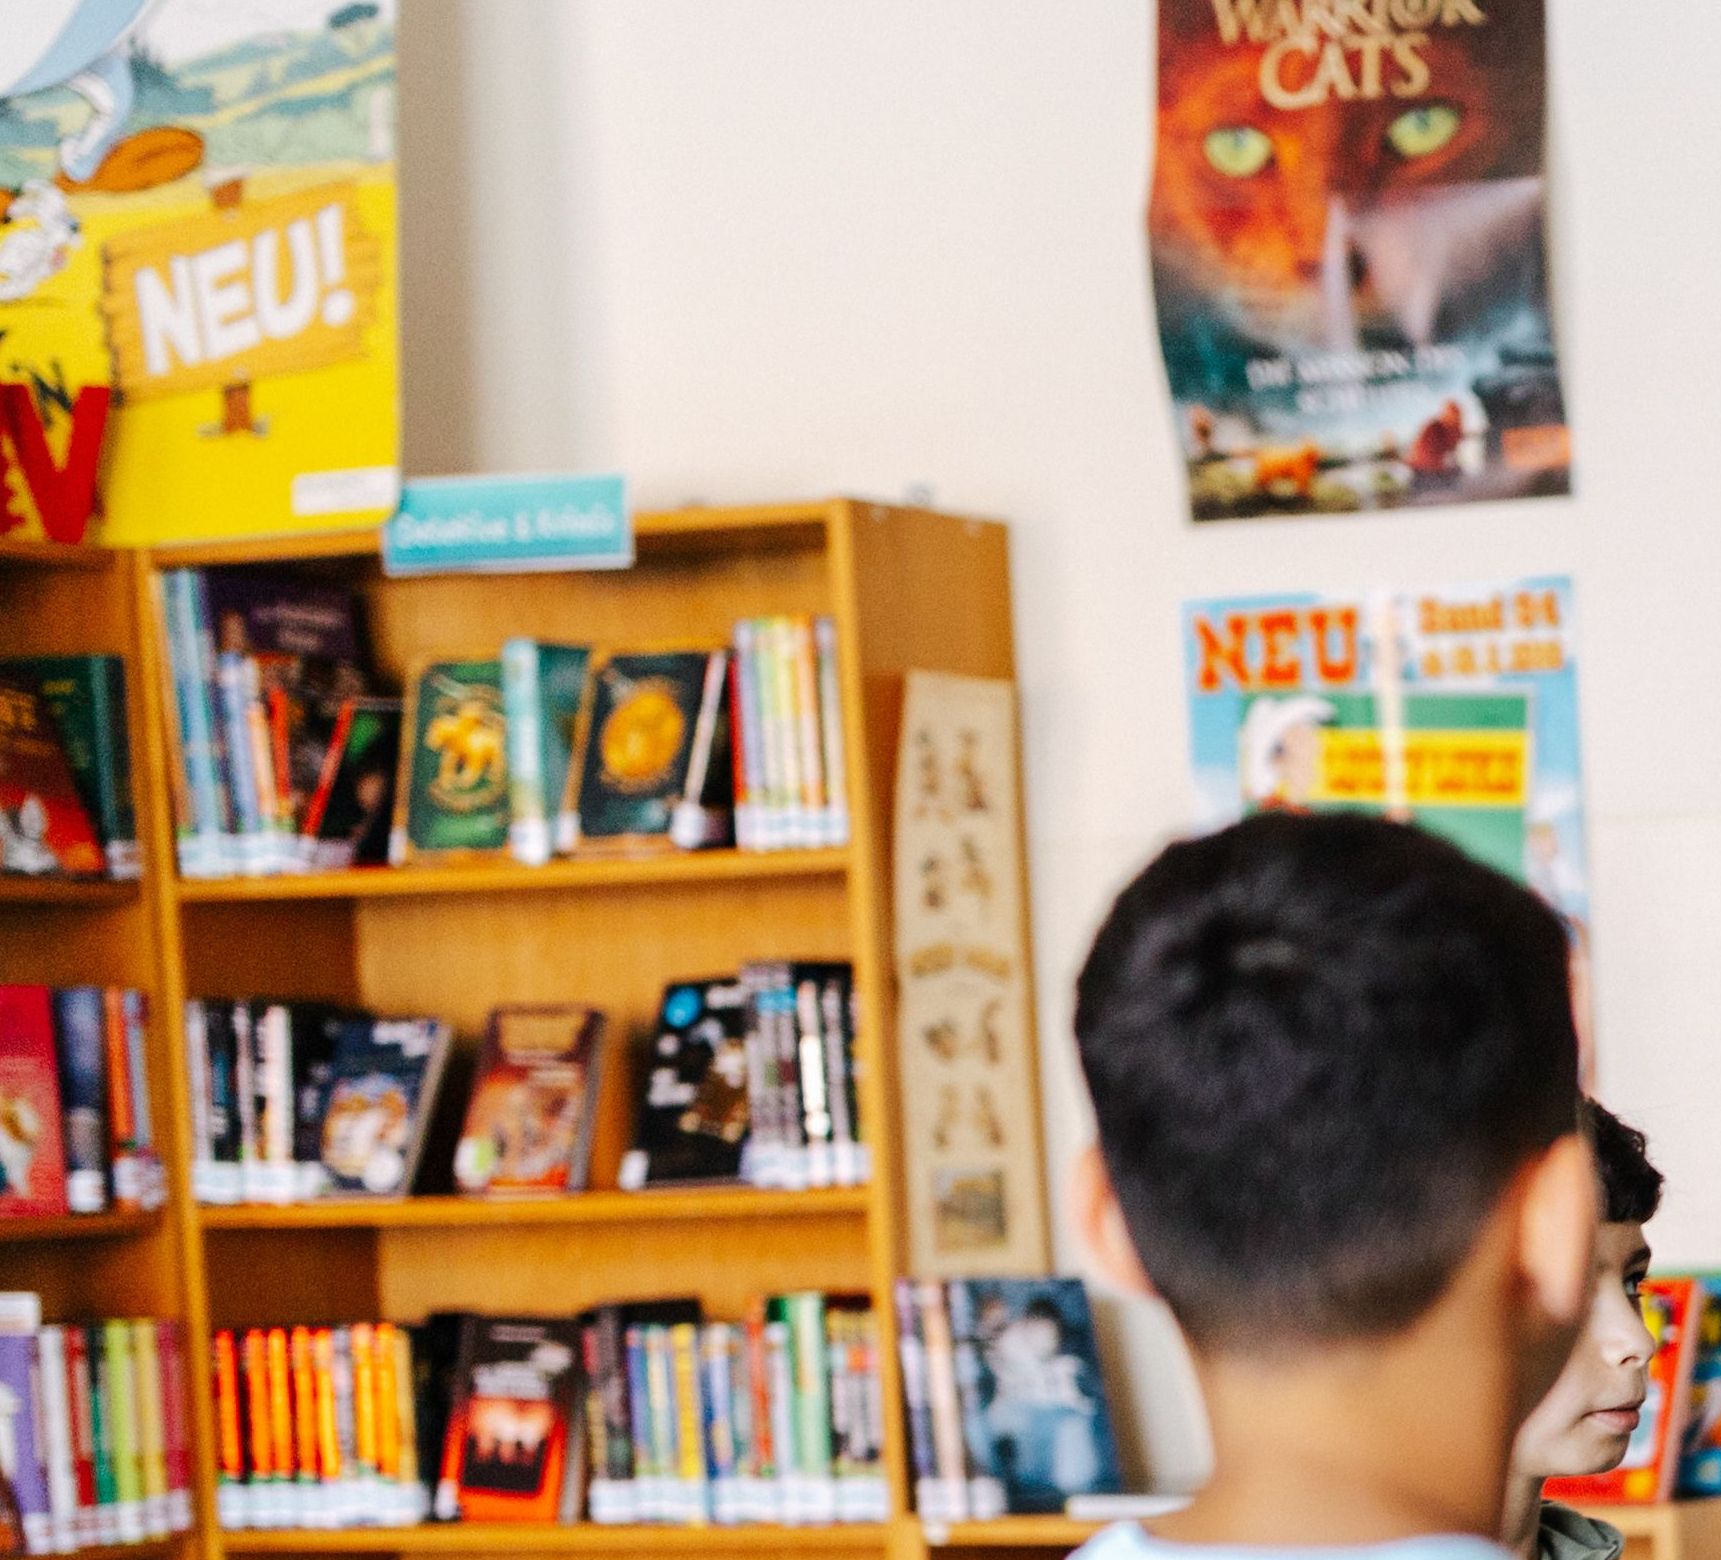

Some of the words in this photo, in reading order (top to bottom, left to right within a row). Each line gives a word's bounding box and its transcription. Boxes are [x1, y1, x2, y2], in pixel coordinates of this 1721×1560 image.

[1258, 32, 1432, 111] CATS
[133, 202, 356, 377] NEU!
[1193, 605, 1361, 693] NEU
